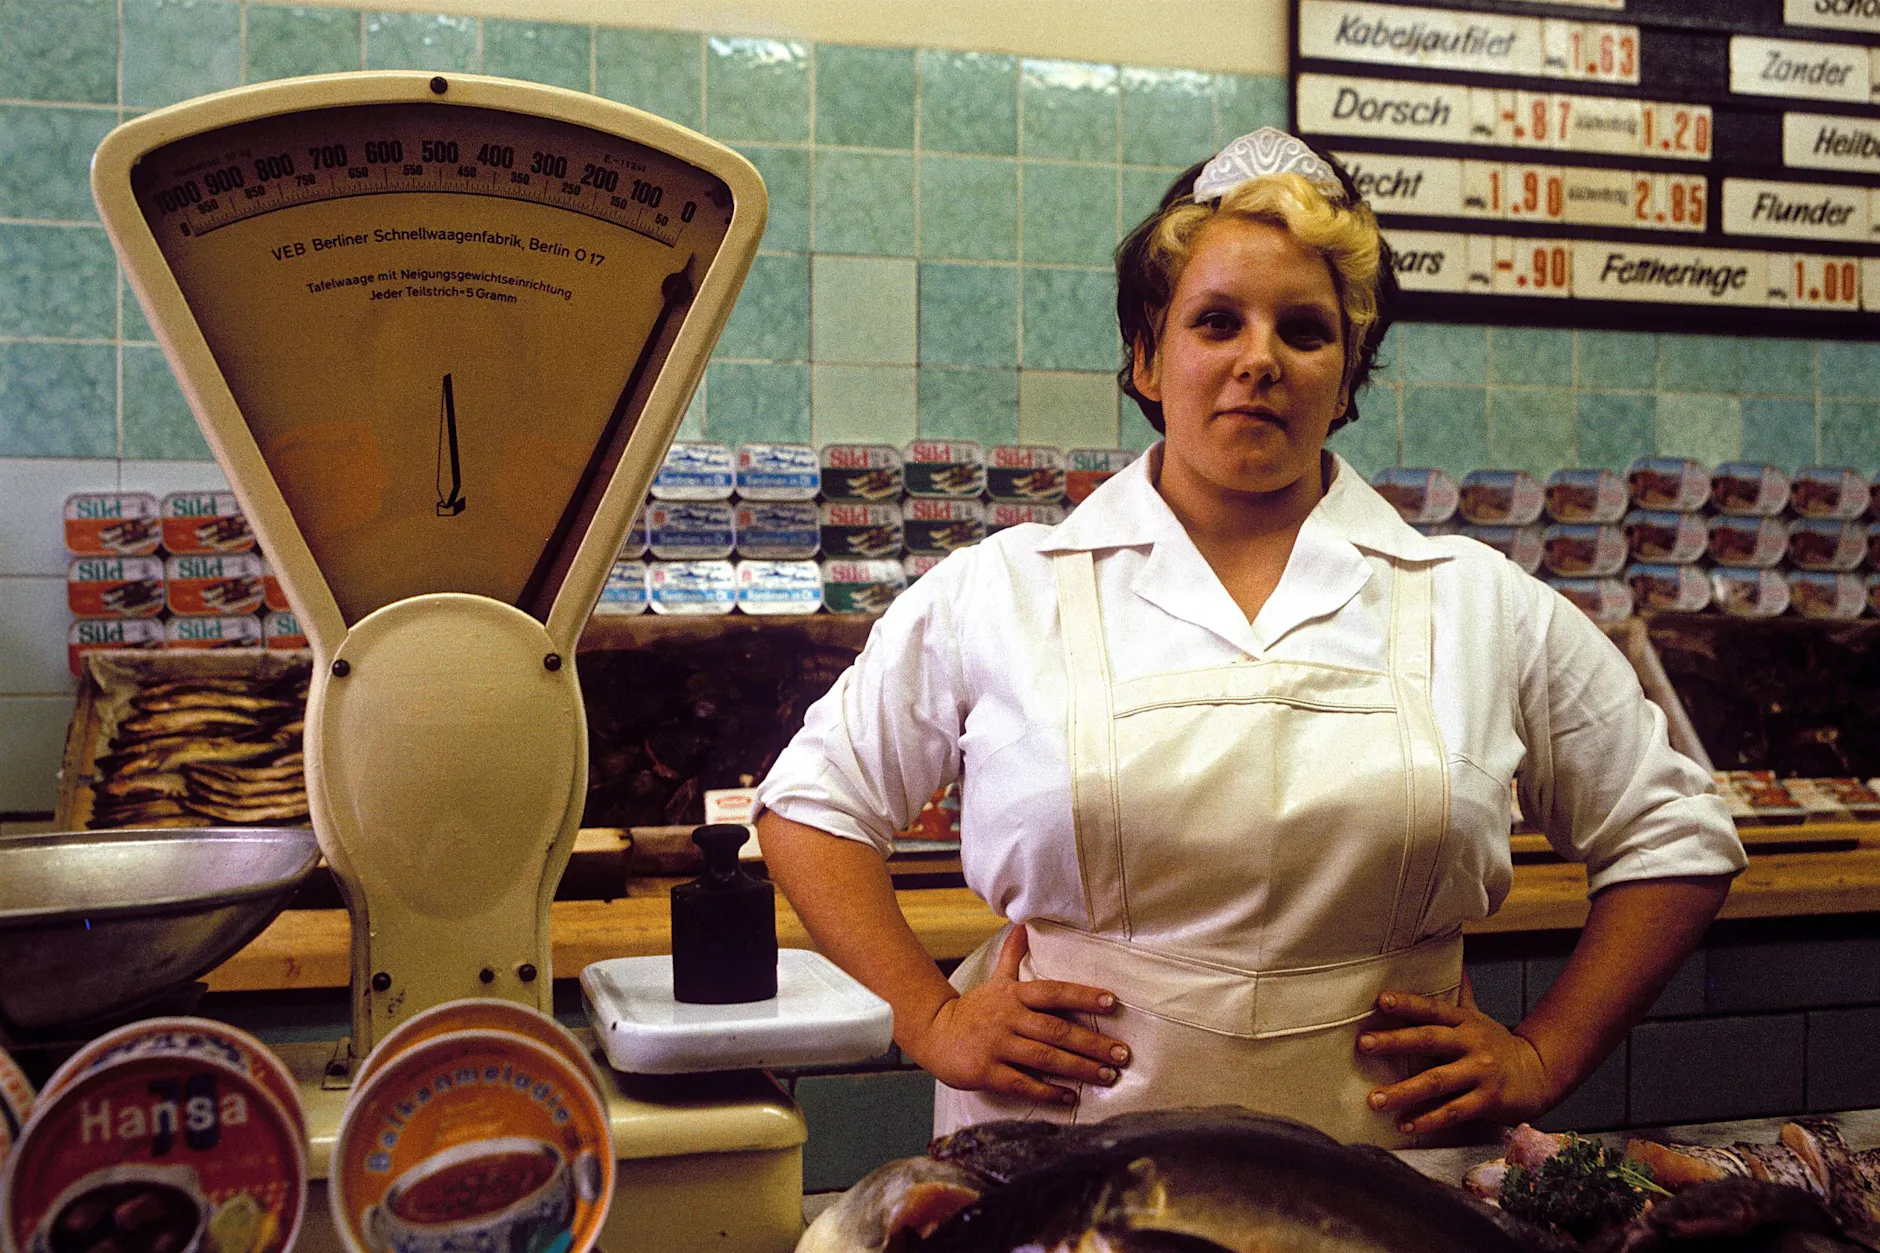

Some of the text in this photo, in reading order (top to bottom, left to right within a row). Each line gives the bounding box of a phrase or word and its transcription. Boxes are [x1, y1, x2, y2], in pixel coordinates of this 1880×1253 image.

[1335, 14, 1636, 76] Kabeljaufilet 1.63
[1761, 50, 1853, 86] Zander
[1332, 87, 1451, 126] Dorsch
[1643, 107, 1709, 154] 1.20
[154, 180, 203, 216] 1000
[203, 165, 245, 196] 900
[254, 153, 295, 182] 800
[308, 144, 348, 171] 700
[365, 140, 404, 164] 600
[421, 140, 459, 164] 500
[477, 143, 514, 169] 400
[531, 151, 567, 179] 300
[580, 163, 619, 193] 200
[631, 179, 663, 209] 100
[681, 201, 697, 224] 0
[1490, 171, 1562, 217] 1.90
[1635, 178, 1704, 227] 2.85
[180, 221, 191, 237] 0
[198, 199, 219, 215] 950
[244, 184, 266, 200] 850
[295, 173, 317, 187] 750
[403, 164, 423, 176] 550
[457, 165, 477, 178] 450
[510, 171, 530, 185] 350
[561, 181, 581, 196] 250
[610, 195, 628, 210] 150
[654, 212, 669, 227] 50
[1751, 192, 1855, 227] Flunder
[271, 226, 606, 268] VEB Berliner Schnellwaagenfabrik, Berlin O 17
[1391, 250, 1444, 276] ars
[307, 267, 573, 301] Tafelwaage mit Neigungsgewichtseinrichtung
[1600, 252, 1856, 302] Fettheringe 1.00
[369, 286, 403, 302] Jeder
[476, 286, 517, 304] Gramm
[77, 499, 121, 519] Sild
[173, 497, 217, 517] Sild
[78, 560, 123, 581] Sild
[179, 558, 223, 578] Sild
[79, 622, 124, 644] Sild
[178, 620, 222, 640] Sild
[80, 1092, 248, 1145] Hansa
